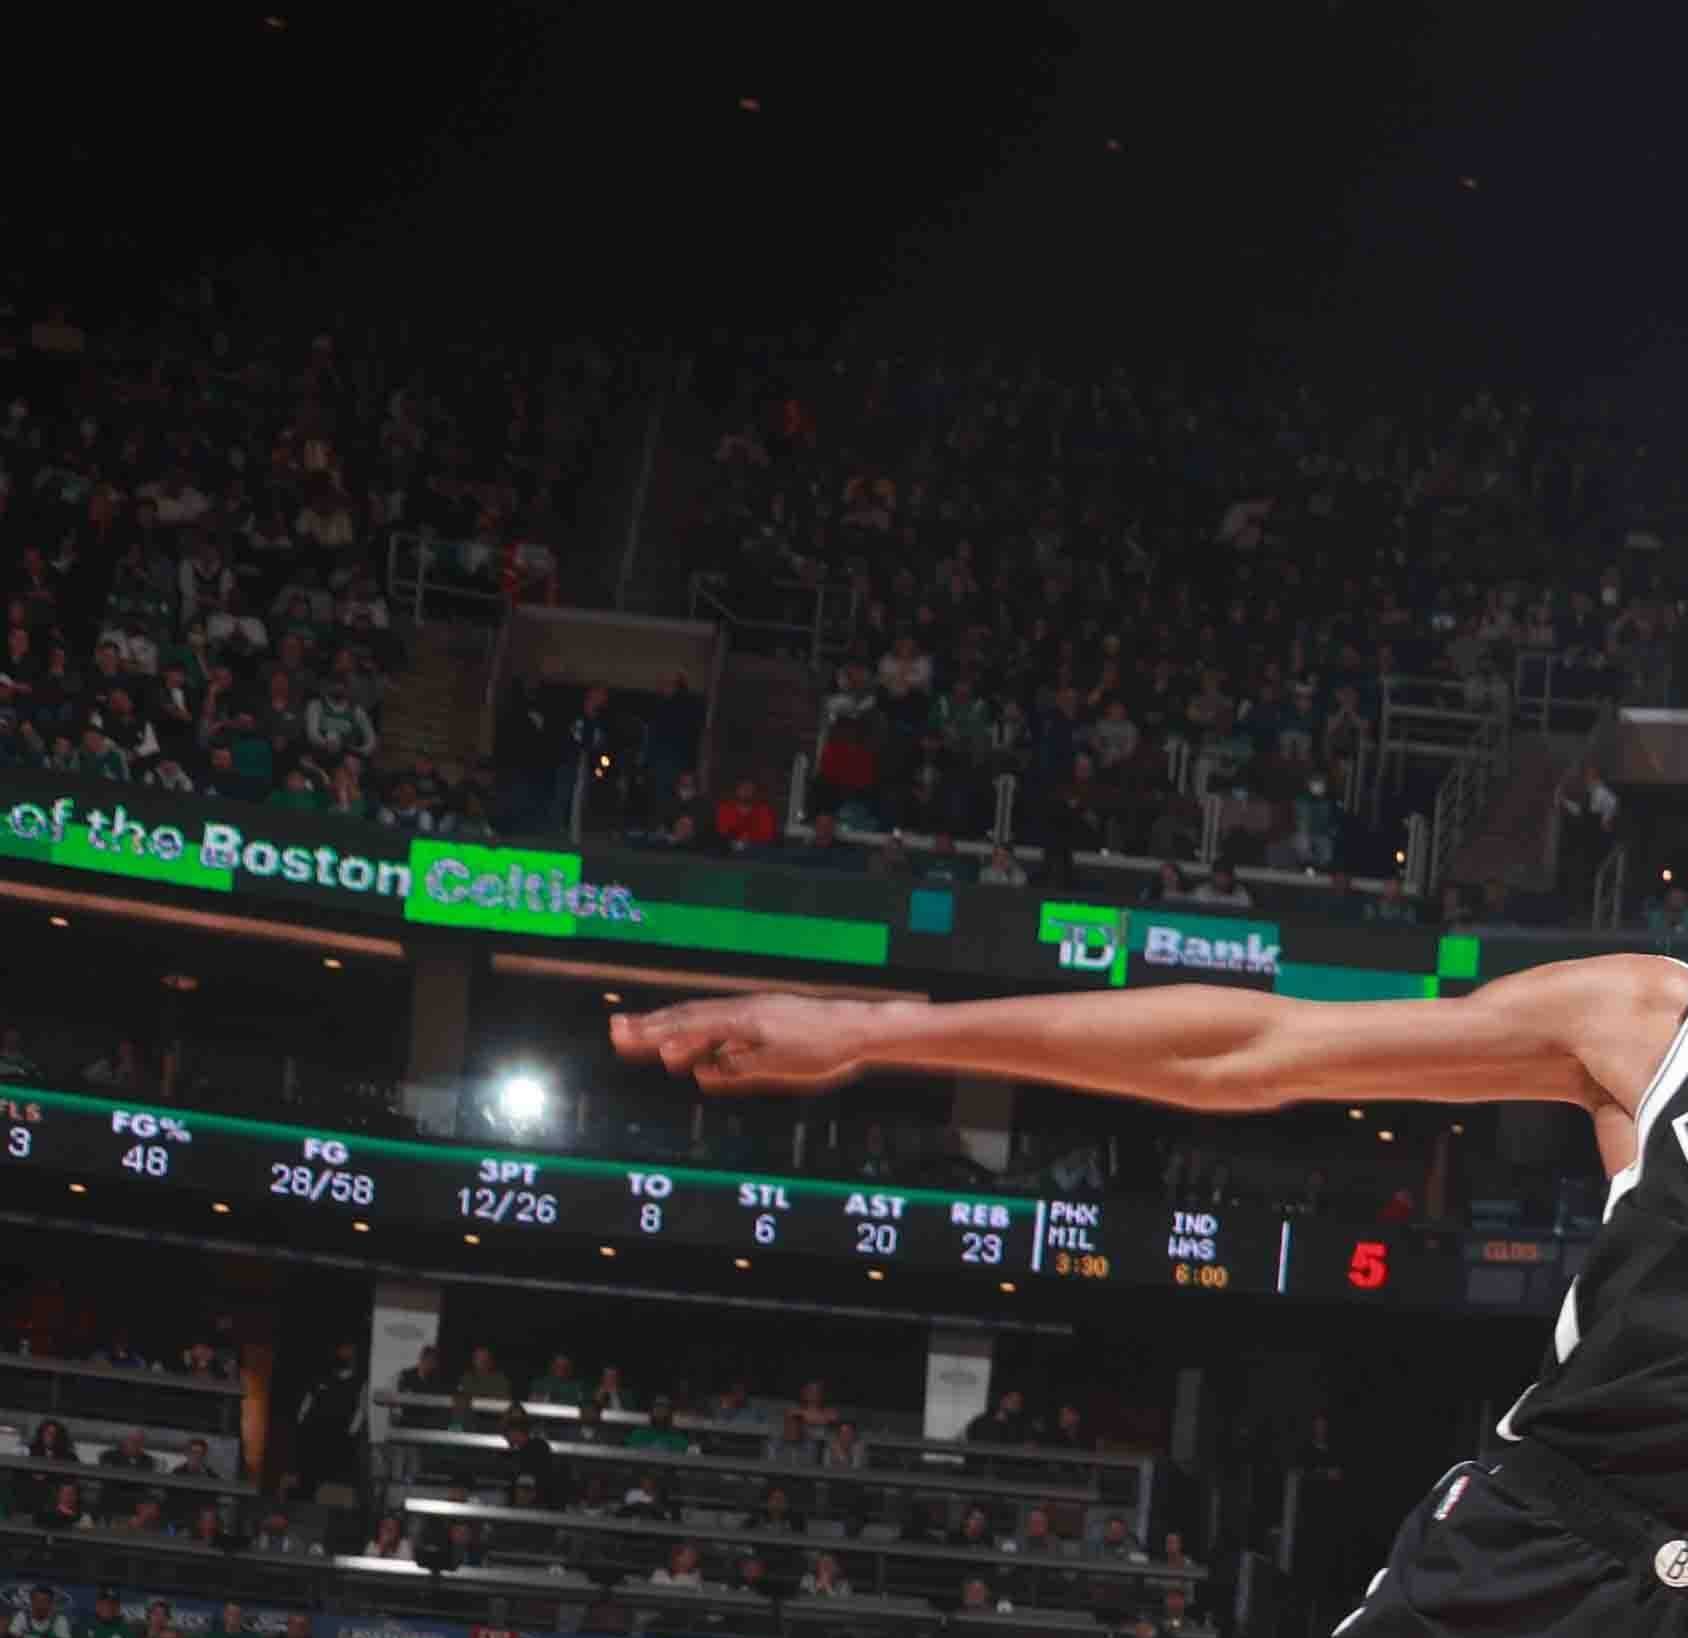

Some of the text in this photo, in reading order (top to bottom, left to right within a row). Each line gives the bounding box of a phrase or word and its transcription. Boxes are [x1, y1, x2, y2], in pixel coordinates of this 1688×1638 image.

[87, 805, 184, 860] the
[200, 822, 412, 897] Boston
[1143, 925, 1281, 977] Bank
[8, 1126, 32, 1158] 3
[112, 1109, 193, 1144] FG%
[121, 1143, 169, 1178] 48
[303, 1137, 350, 1166] FG
[269, 1162, 375, 1205] 28/58
[477, 1157, 540, 1187] 3PT
[626, 1171, 674, 1199] TO
[457, 1186, 559, 1224] 12/26
[737, 1182, 791, 1210] STL
[843, 1193, 908, 1219] AST
[639, 1202, 662, 1234] 8
[753, 1213, 776, 1245] 6
[951, 1201, 1011, 1229] REB
[1049, 1201, 1100, 1226] PHX
[1170, 1211, 1219, 1237] IND
[855, 1222, 898, 1256] 20
[1047, 1227, 1096, 1252] MIL
[1346, 1238, 1390, 1291] 5
